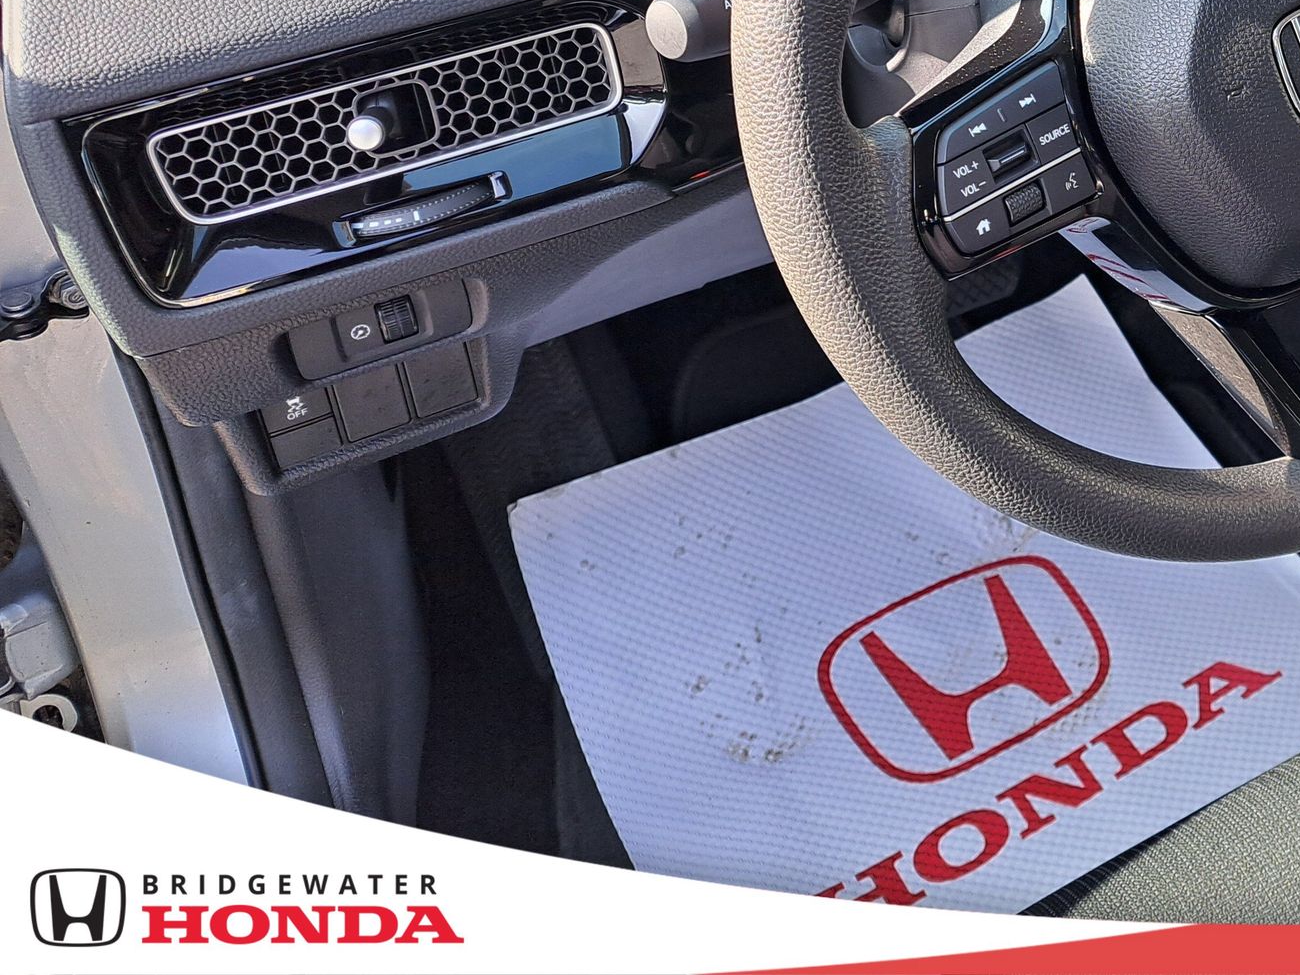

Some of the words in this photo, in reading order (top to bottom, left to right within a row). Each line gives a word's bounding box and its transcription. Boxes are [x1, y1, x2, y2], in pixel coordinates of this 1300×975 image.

[1039, 123, 1071, 146] SOURCE
[287, 407, 308, 420] OFF
[812, 659, 1284, 906] HONDA
